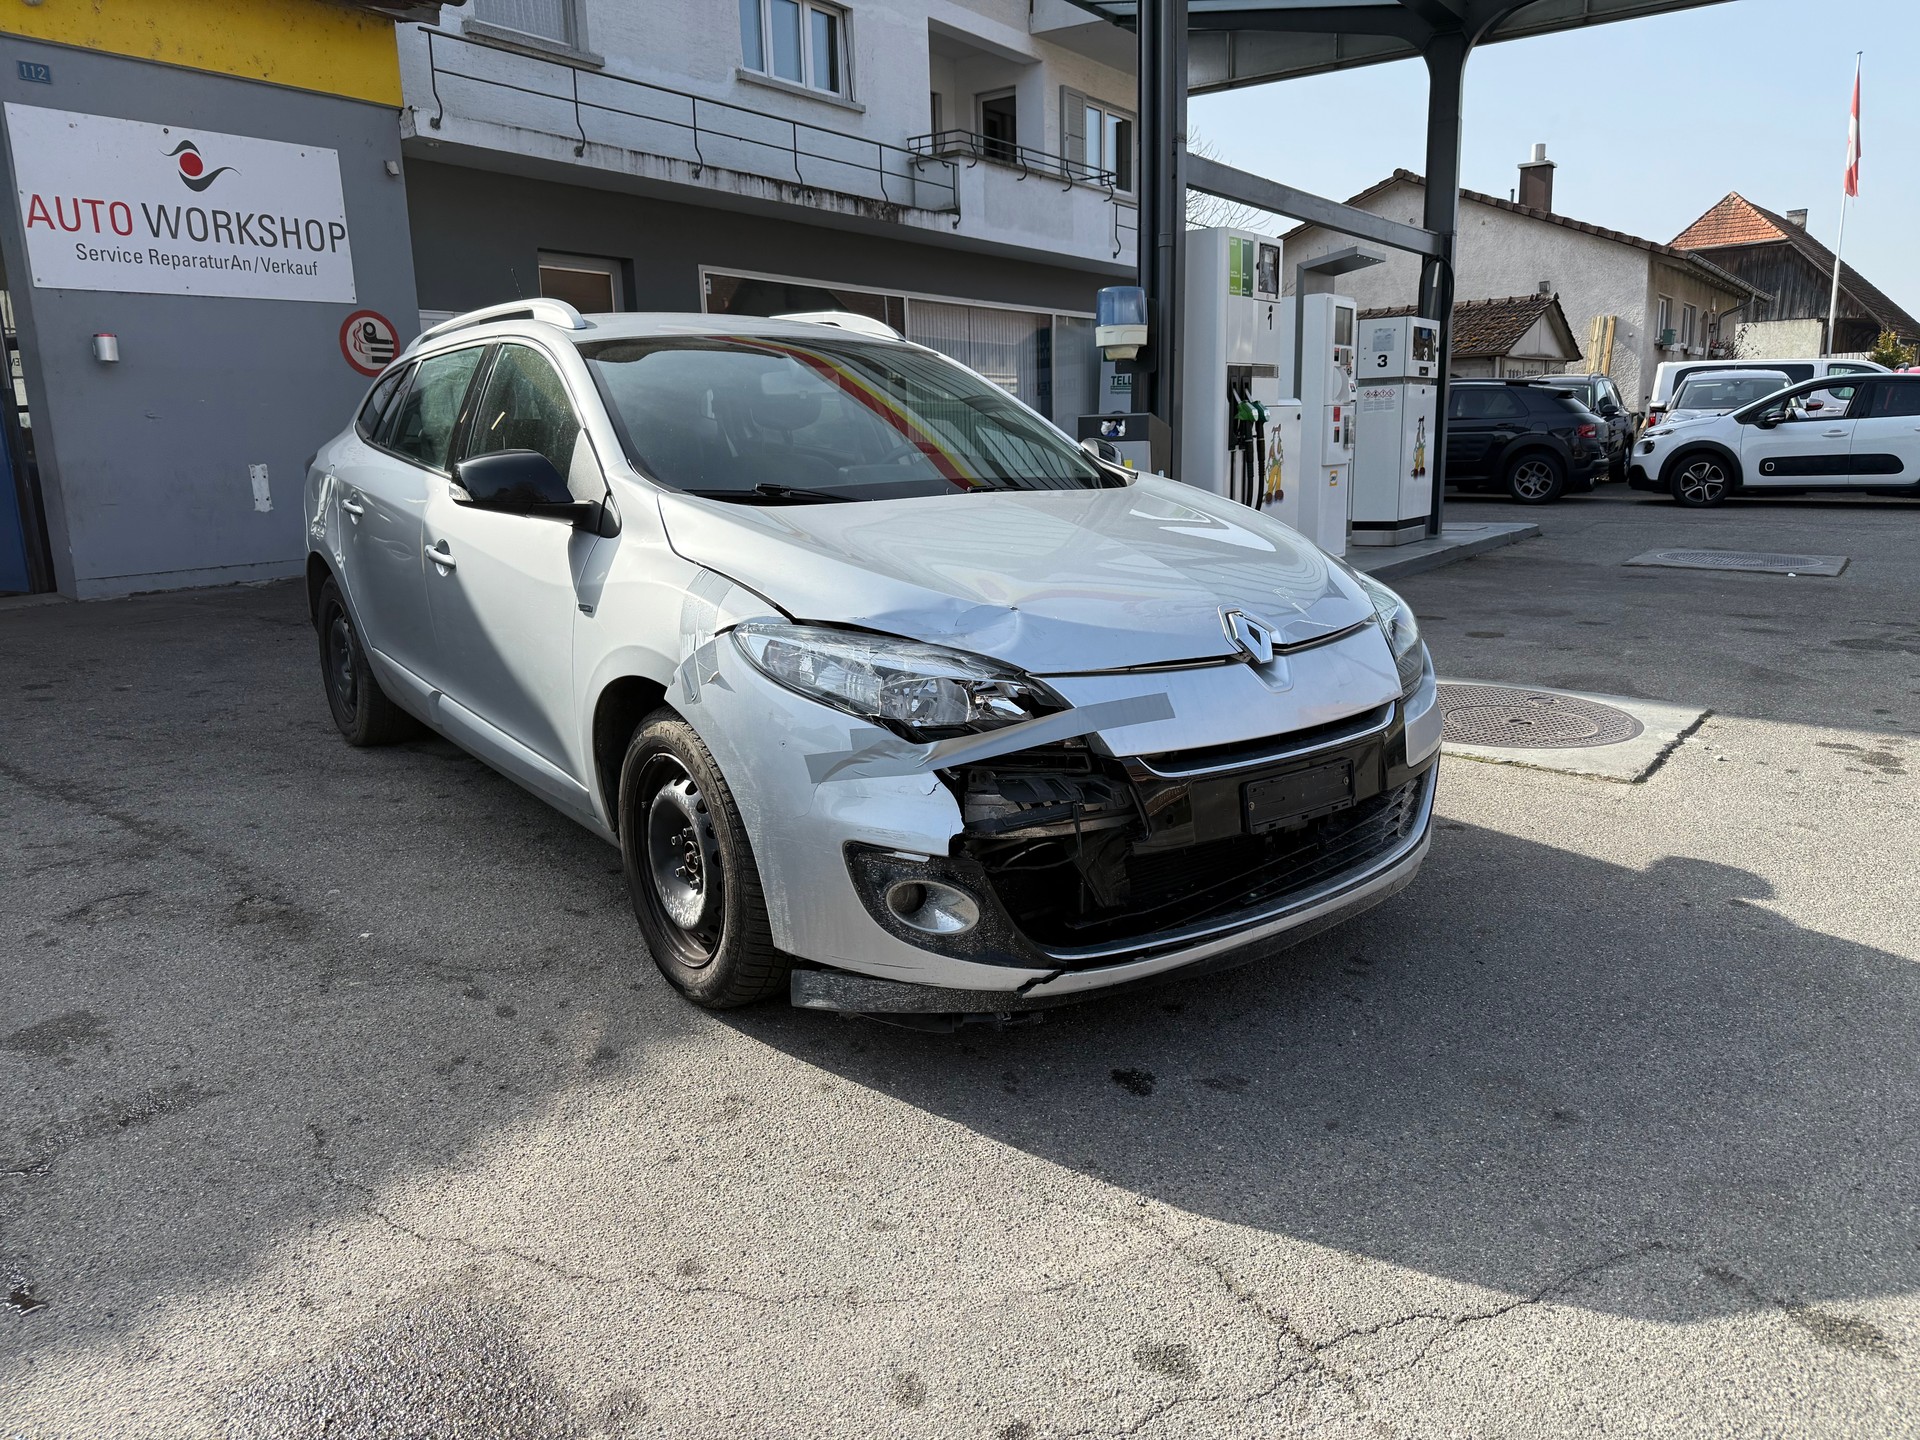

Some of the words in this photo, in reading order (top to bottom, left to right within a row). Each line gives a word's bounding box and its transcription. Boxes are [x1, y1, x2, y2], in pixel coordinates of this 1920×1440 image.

[21, 63, 47, 80] 112
[26, 193, 133, 237] AUTO
[140, 202, 346, 253] WORKSHOP
[75, 243, 143, 265] Service
[1377, 354, 1388, 368] 3
[1424, 347, 1429, 361] 3
[660, 726, 695, 764] POLARIS
